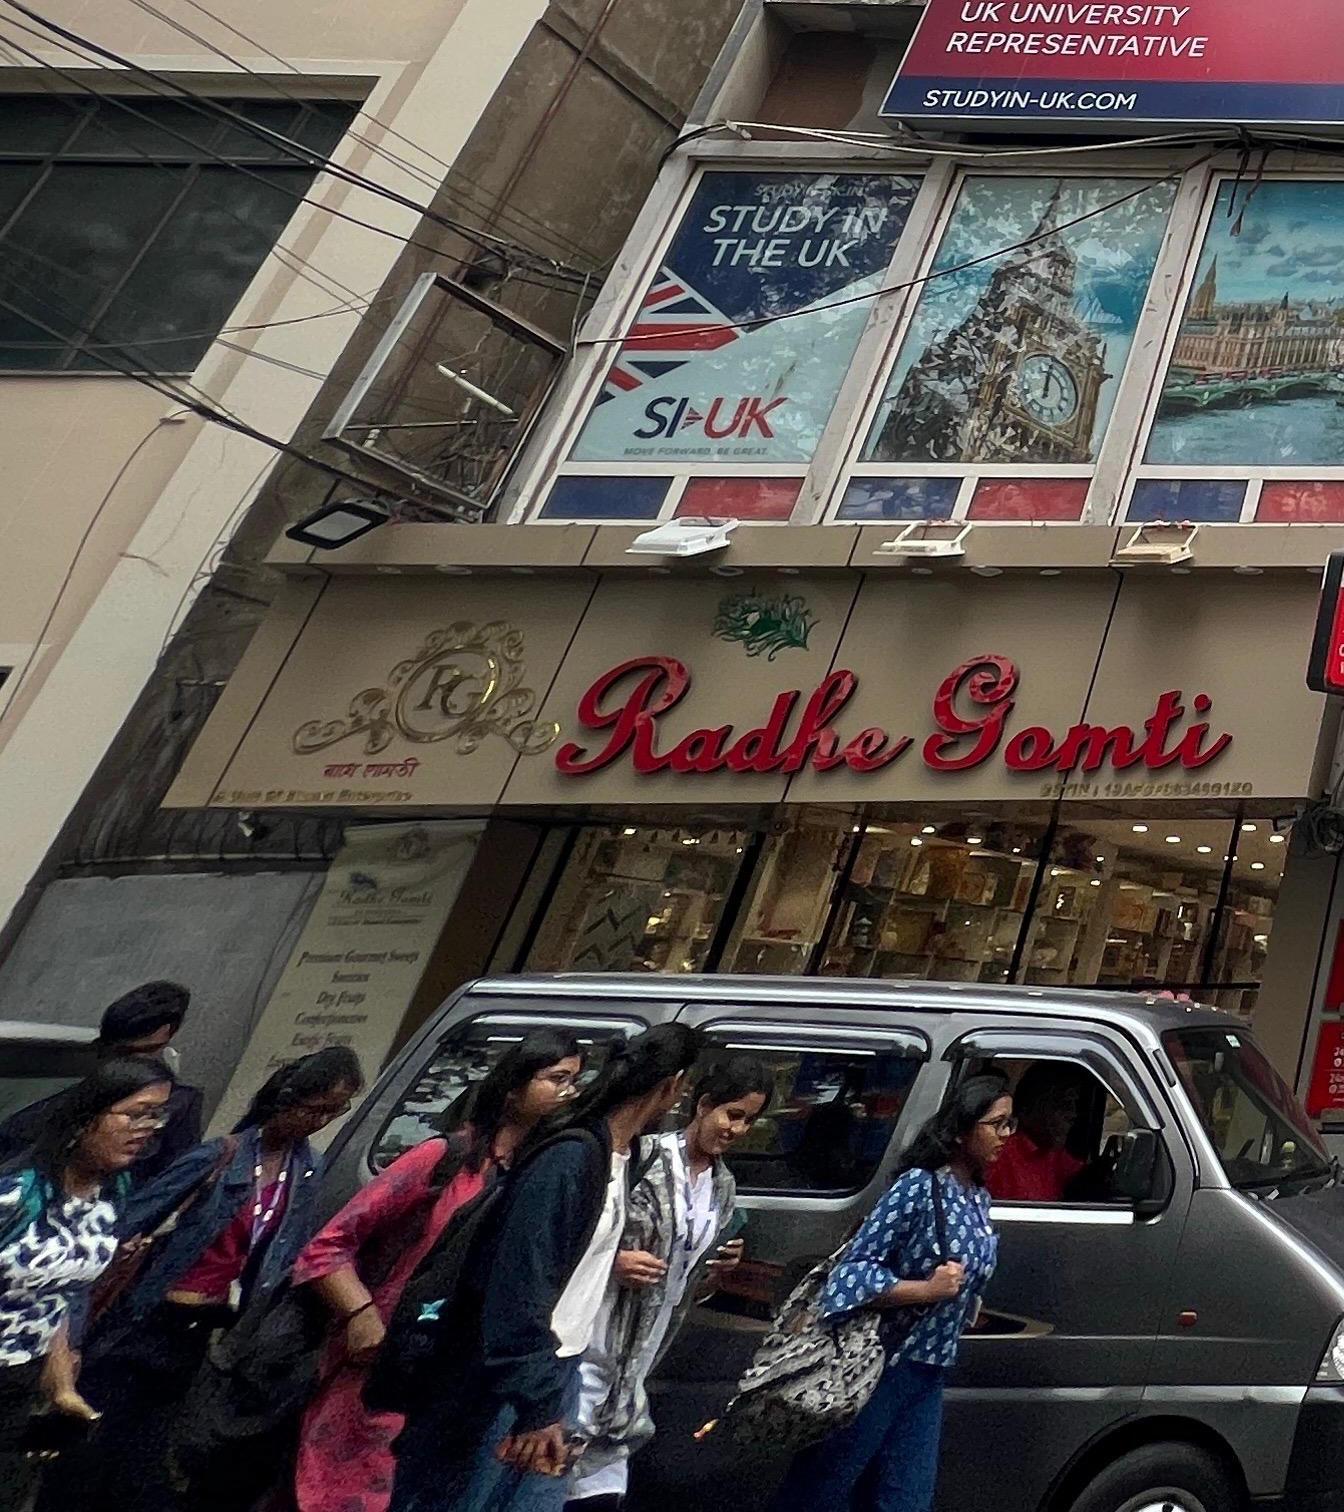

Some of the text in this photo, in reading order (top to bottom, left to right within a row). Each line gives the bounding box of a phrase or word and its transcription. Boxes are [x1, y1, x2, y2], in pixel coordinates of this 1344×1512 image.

[960, 2, 1190, 28] UK UNIVERSITY
[945, 32, 1208, 59] REPRESENTATIVE
[922, 89, 1137, 112] STUDYIN-UK.COM
[703, 205, 890, 235] STUDY IN
[712, 239, 859, 267] THE UK
[717, 447, 732, 456] BE
[554, 653, 1234, 776] Radhe Gomti
